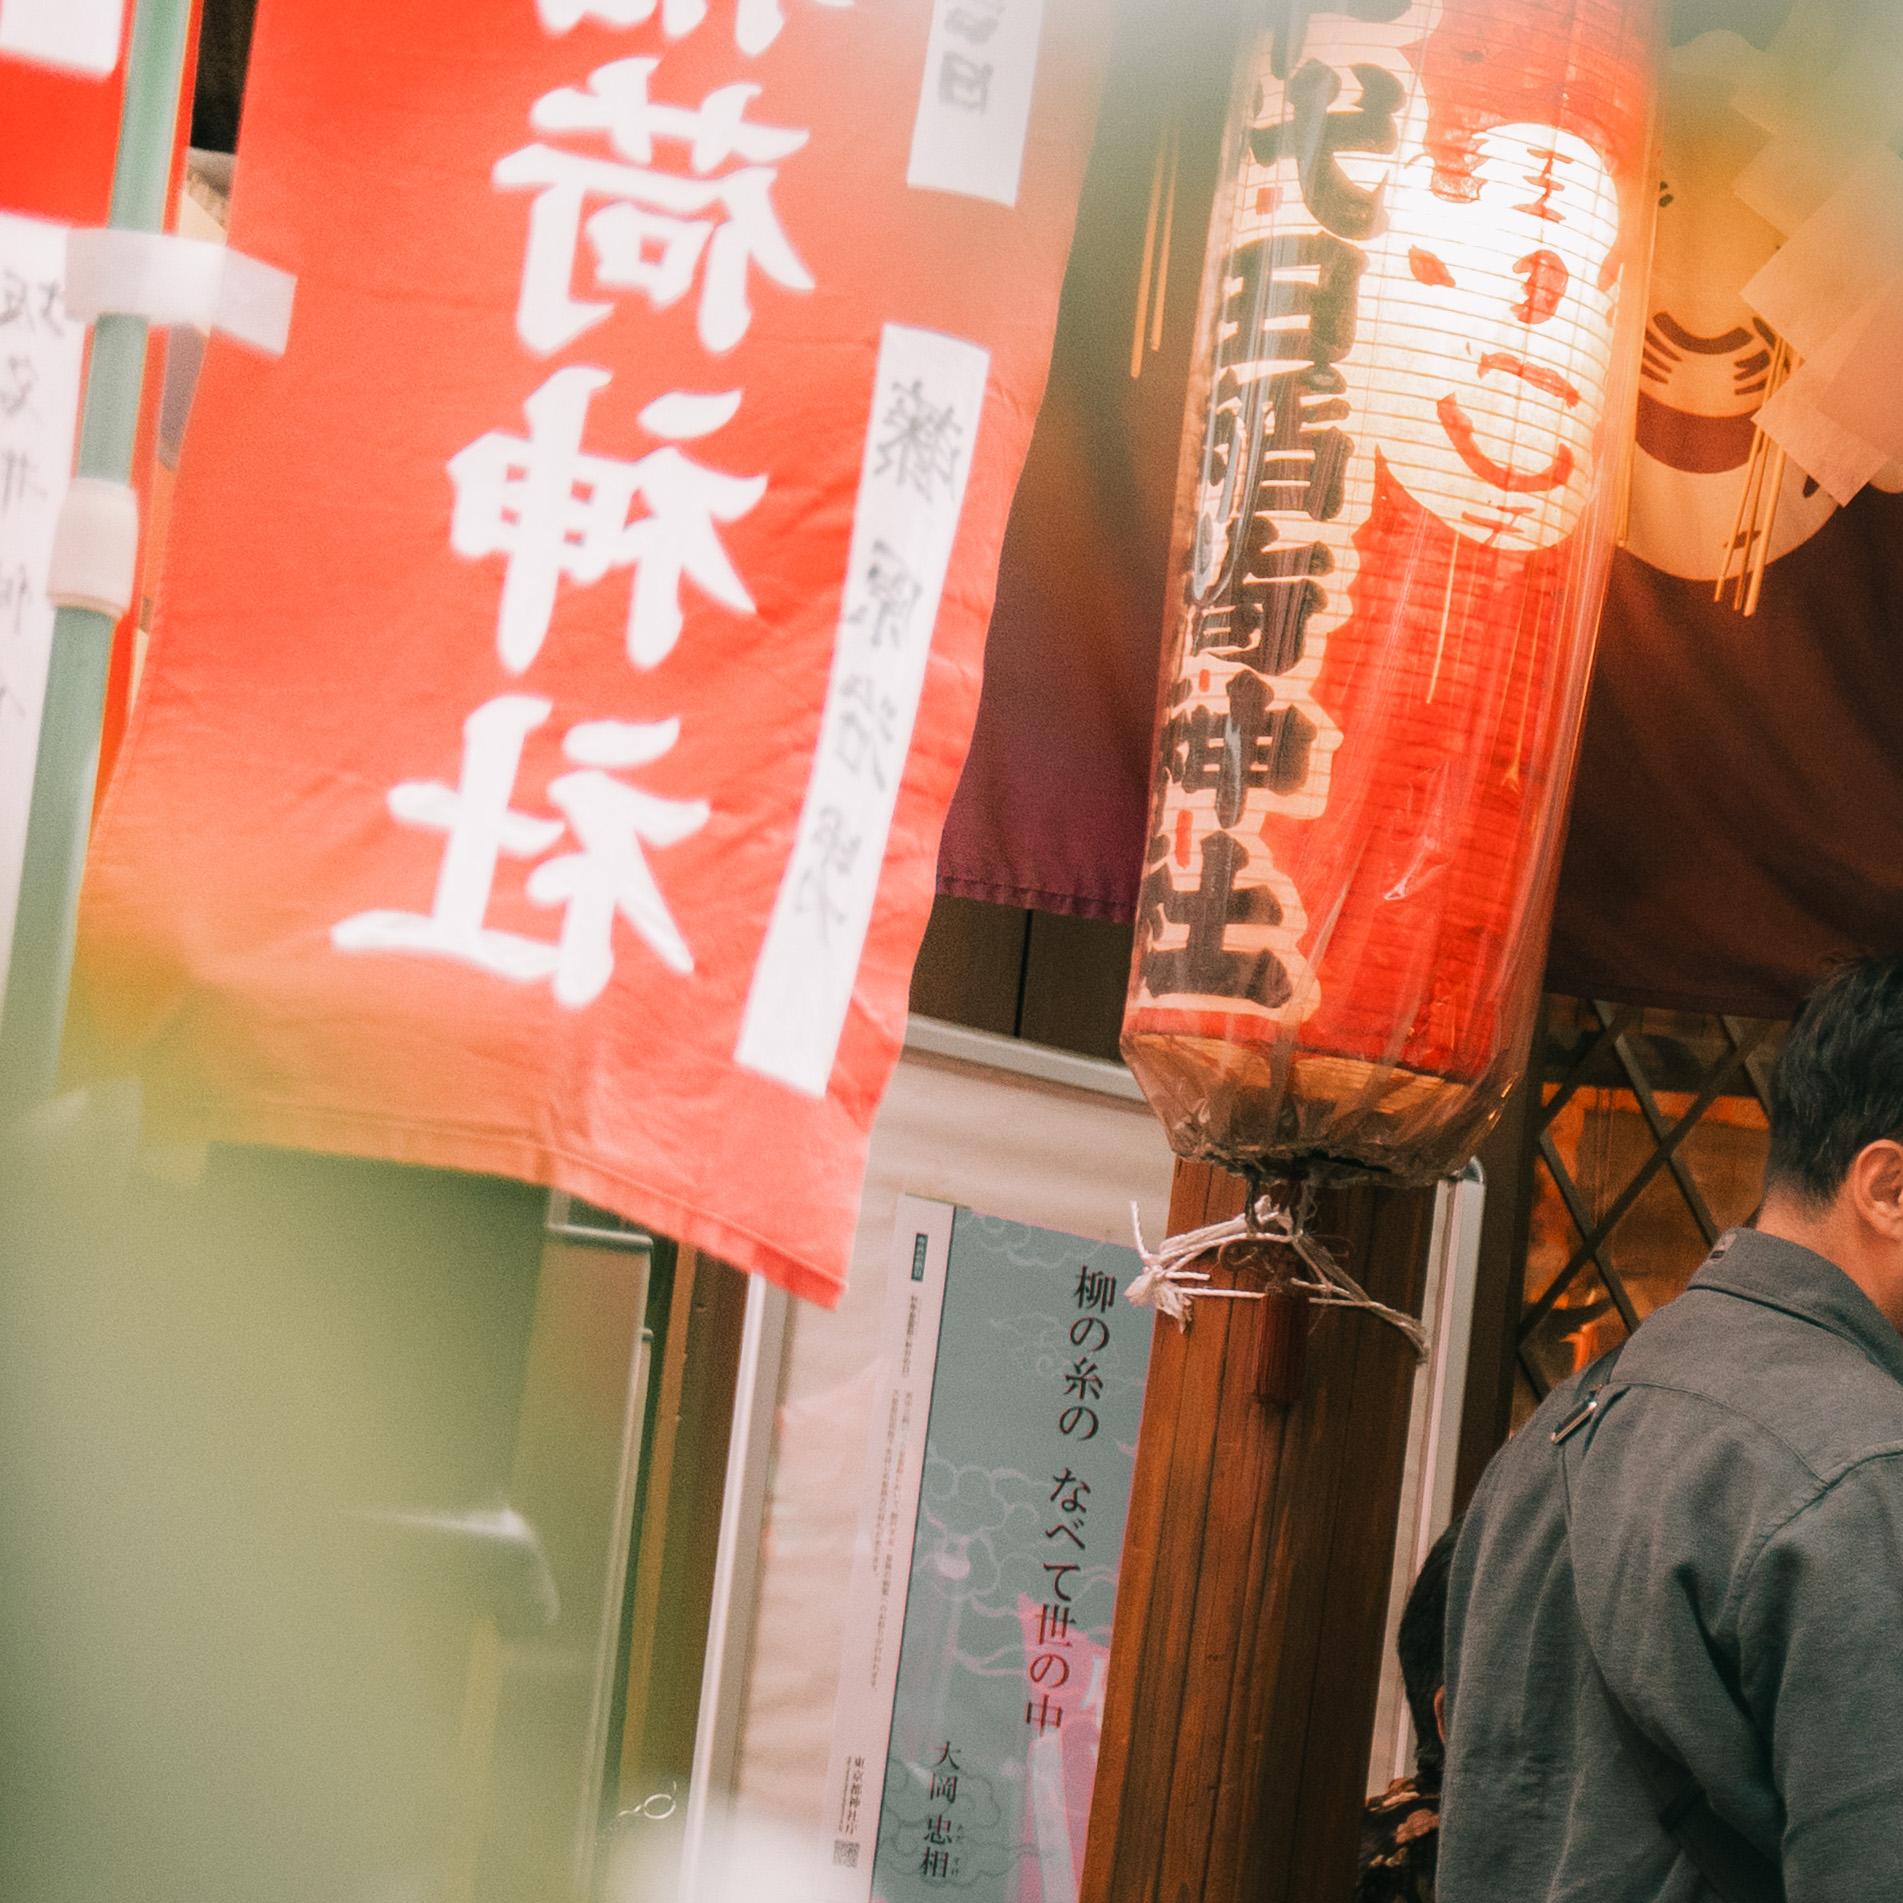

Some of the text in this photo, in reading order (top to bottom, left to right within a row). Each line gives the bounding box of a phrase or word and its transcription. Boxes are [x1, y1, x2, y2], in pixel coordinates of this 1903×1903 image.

[1026, 1265, 1116, 1738] 柳の糸の なべて世の中
[921, 1741, 962, 1878] 大岡忠相
